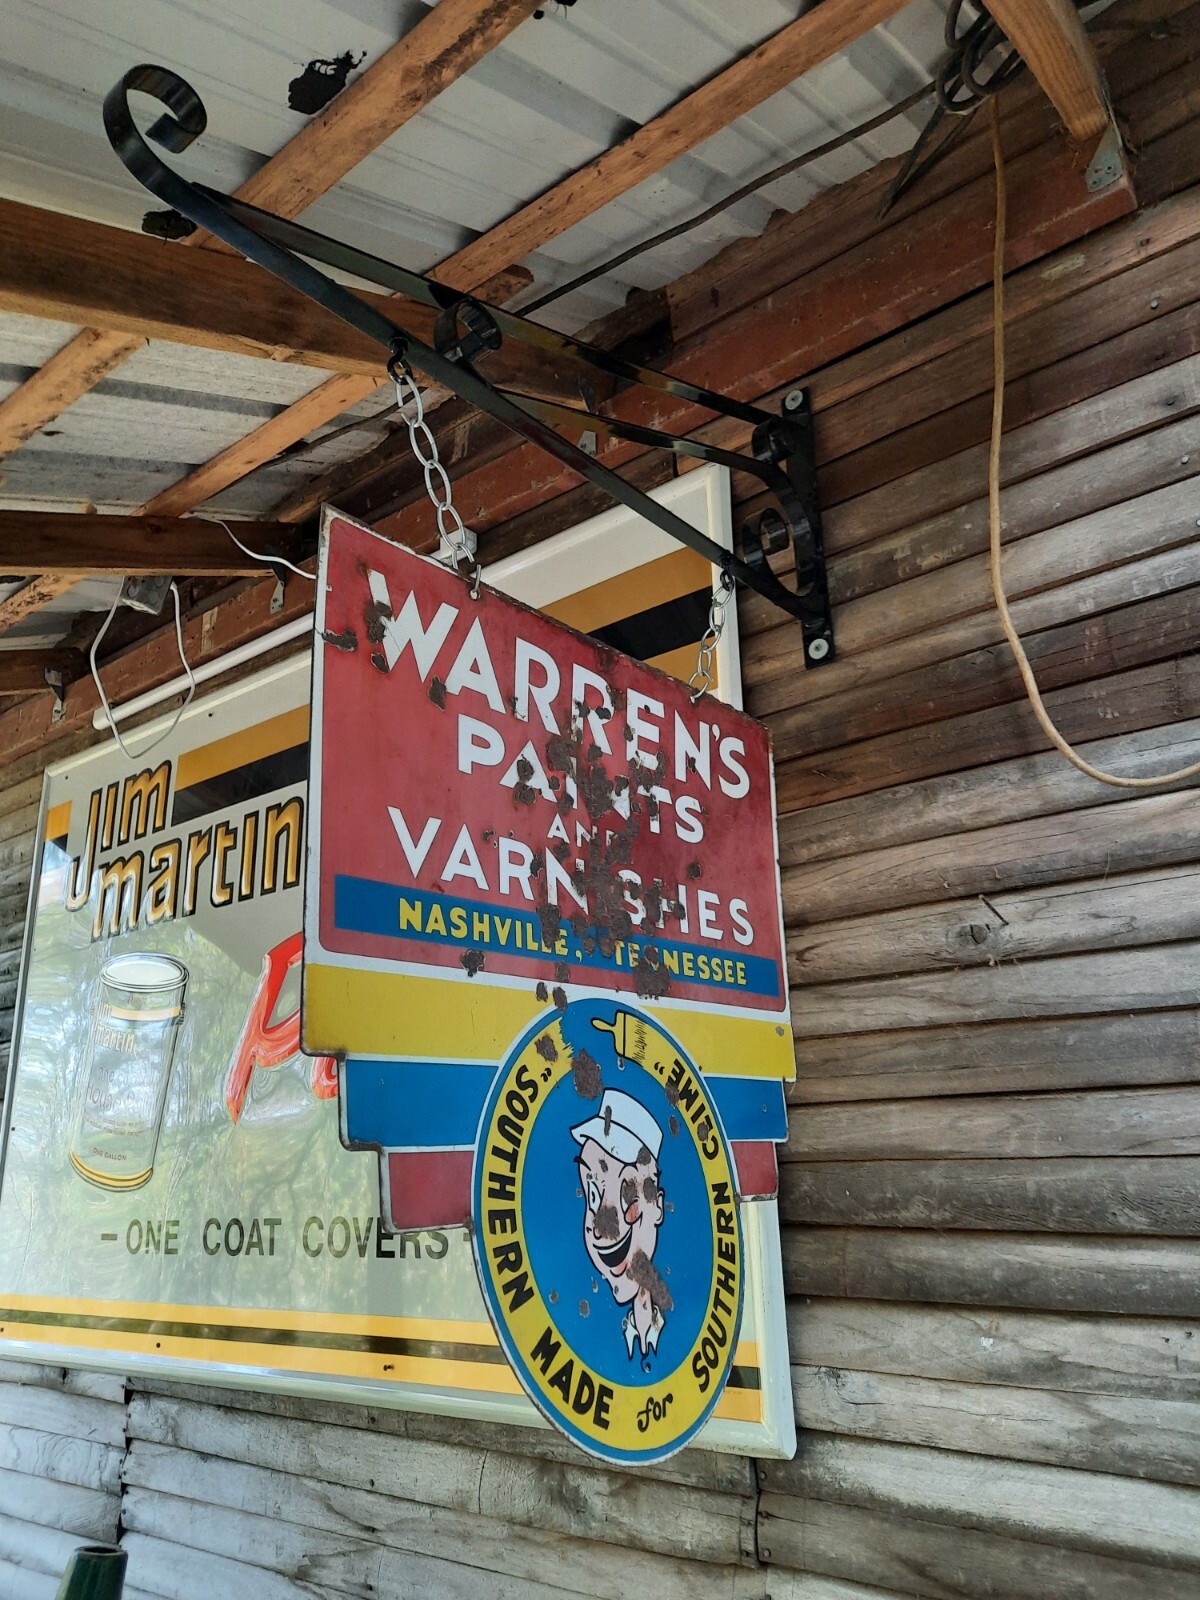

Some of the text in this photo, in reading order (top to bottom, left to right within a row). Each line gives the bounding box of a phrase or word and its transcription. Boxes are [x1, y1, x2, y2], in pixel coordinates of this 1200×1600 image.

[368, 568, 751, 799] WARREN'S
[65, 760, 172, 912] Jim
[91, 796, 305, 943] martin
[387, 806, 754, 946] VARNSHES
[399, 897, 583, 962] NASHVILE,
[202, 1217, 282, 1257] COAT
[302, 1216, 449, 1260] COVERS
[530, 1327, 613, 1430] MADE
[636, 1393, 674, 1433] for
[692, 1181, 736, 1393] SOUTHERN
